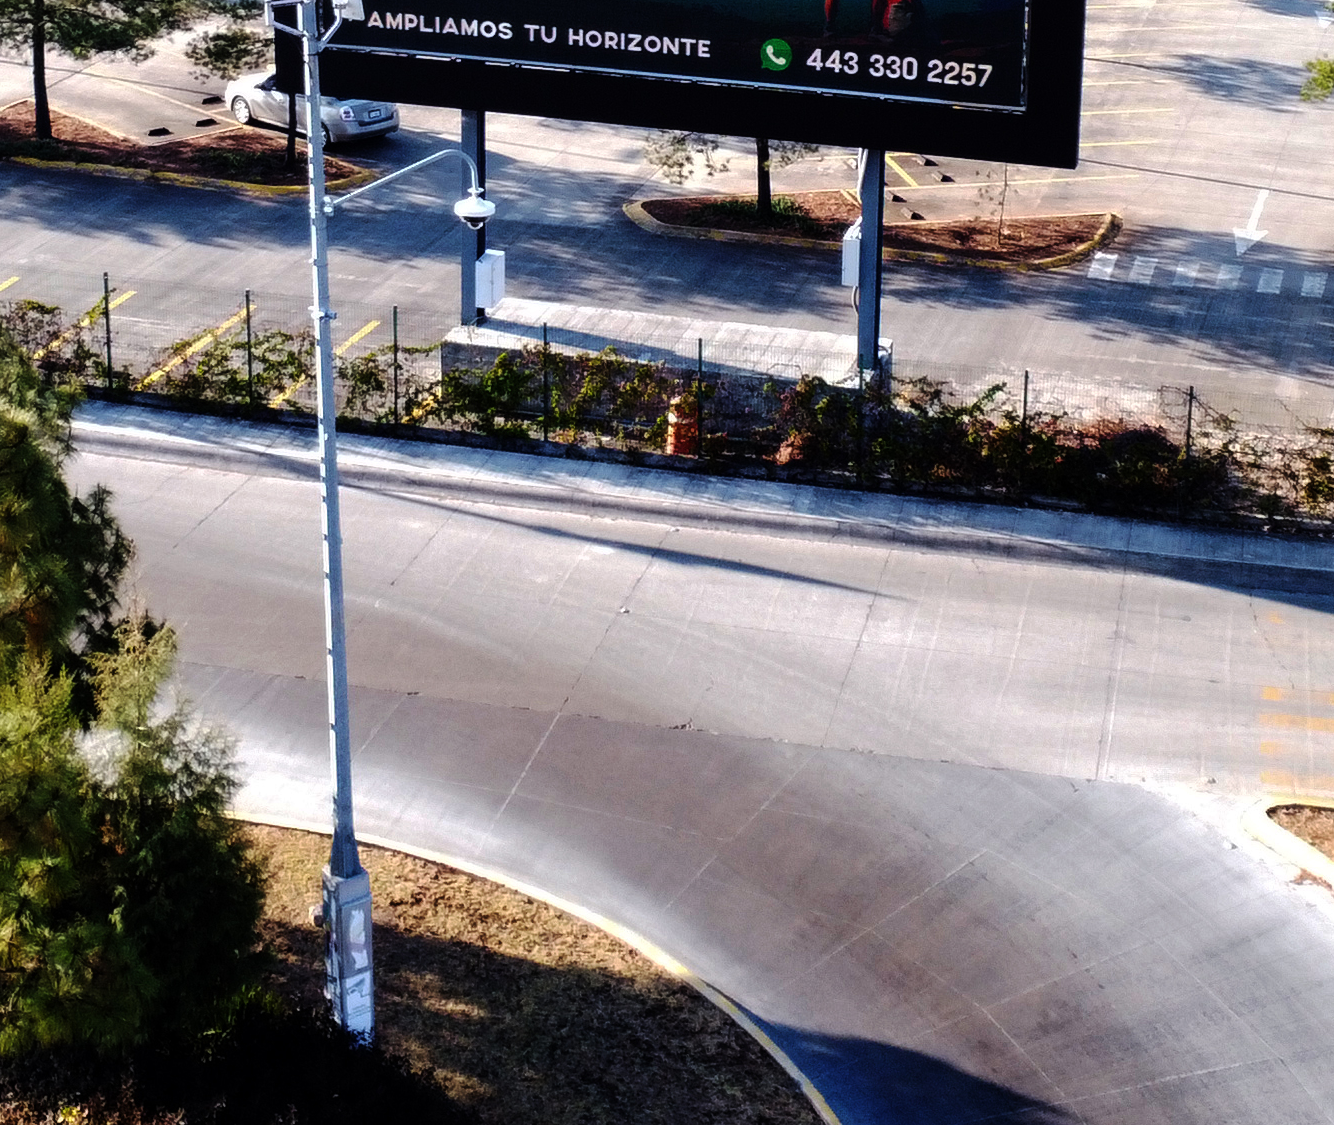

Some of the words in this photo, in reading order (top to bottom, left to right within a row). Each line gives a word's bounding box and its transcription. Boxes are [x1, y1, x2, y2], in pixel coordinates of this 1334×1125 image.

[367, 11, 513, 40] AMPLIAMOS
[524, 24, 557, 43] TU
[568, 28, 711, 58] HORIZONTE
[806, 48, 859, 75] 443
[868, 54, 918, 81] 330
[926, 59, 993, 88] 2257
